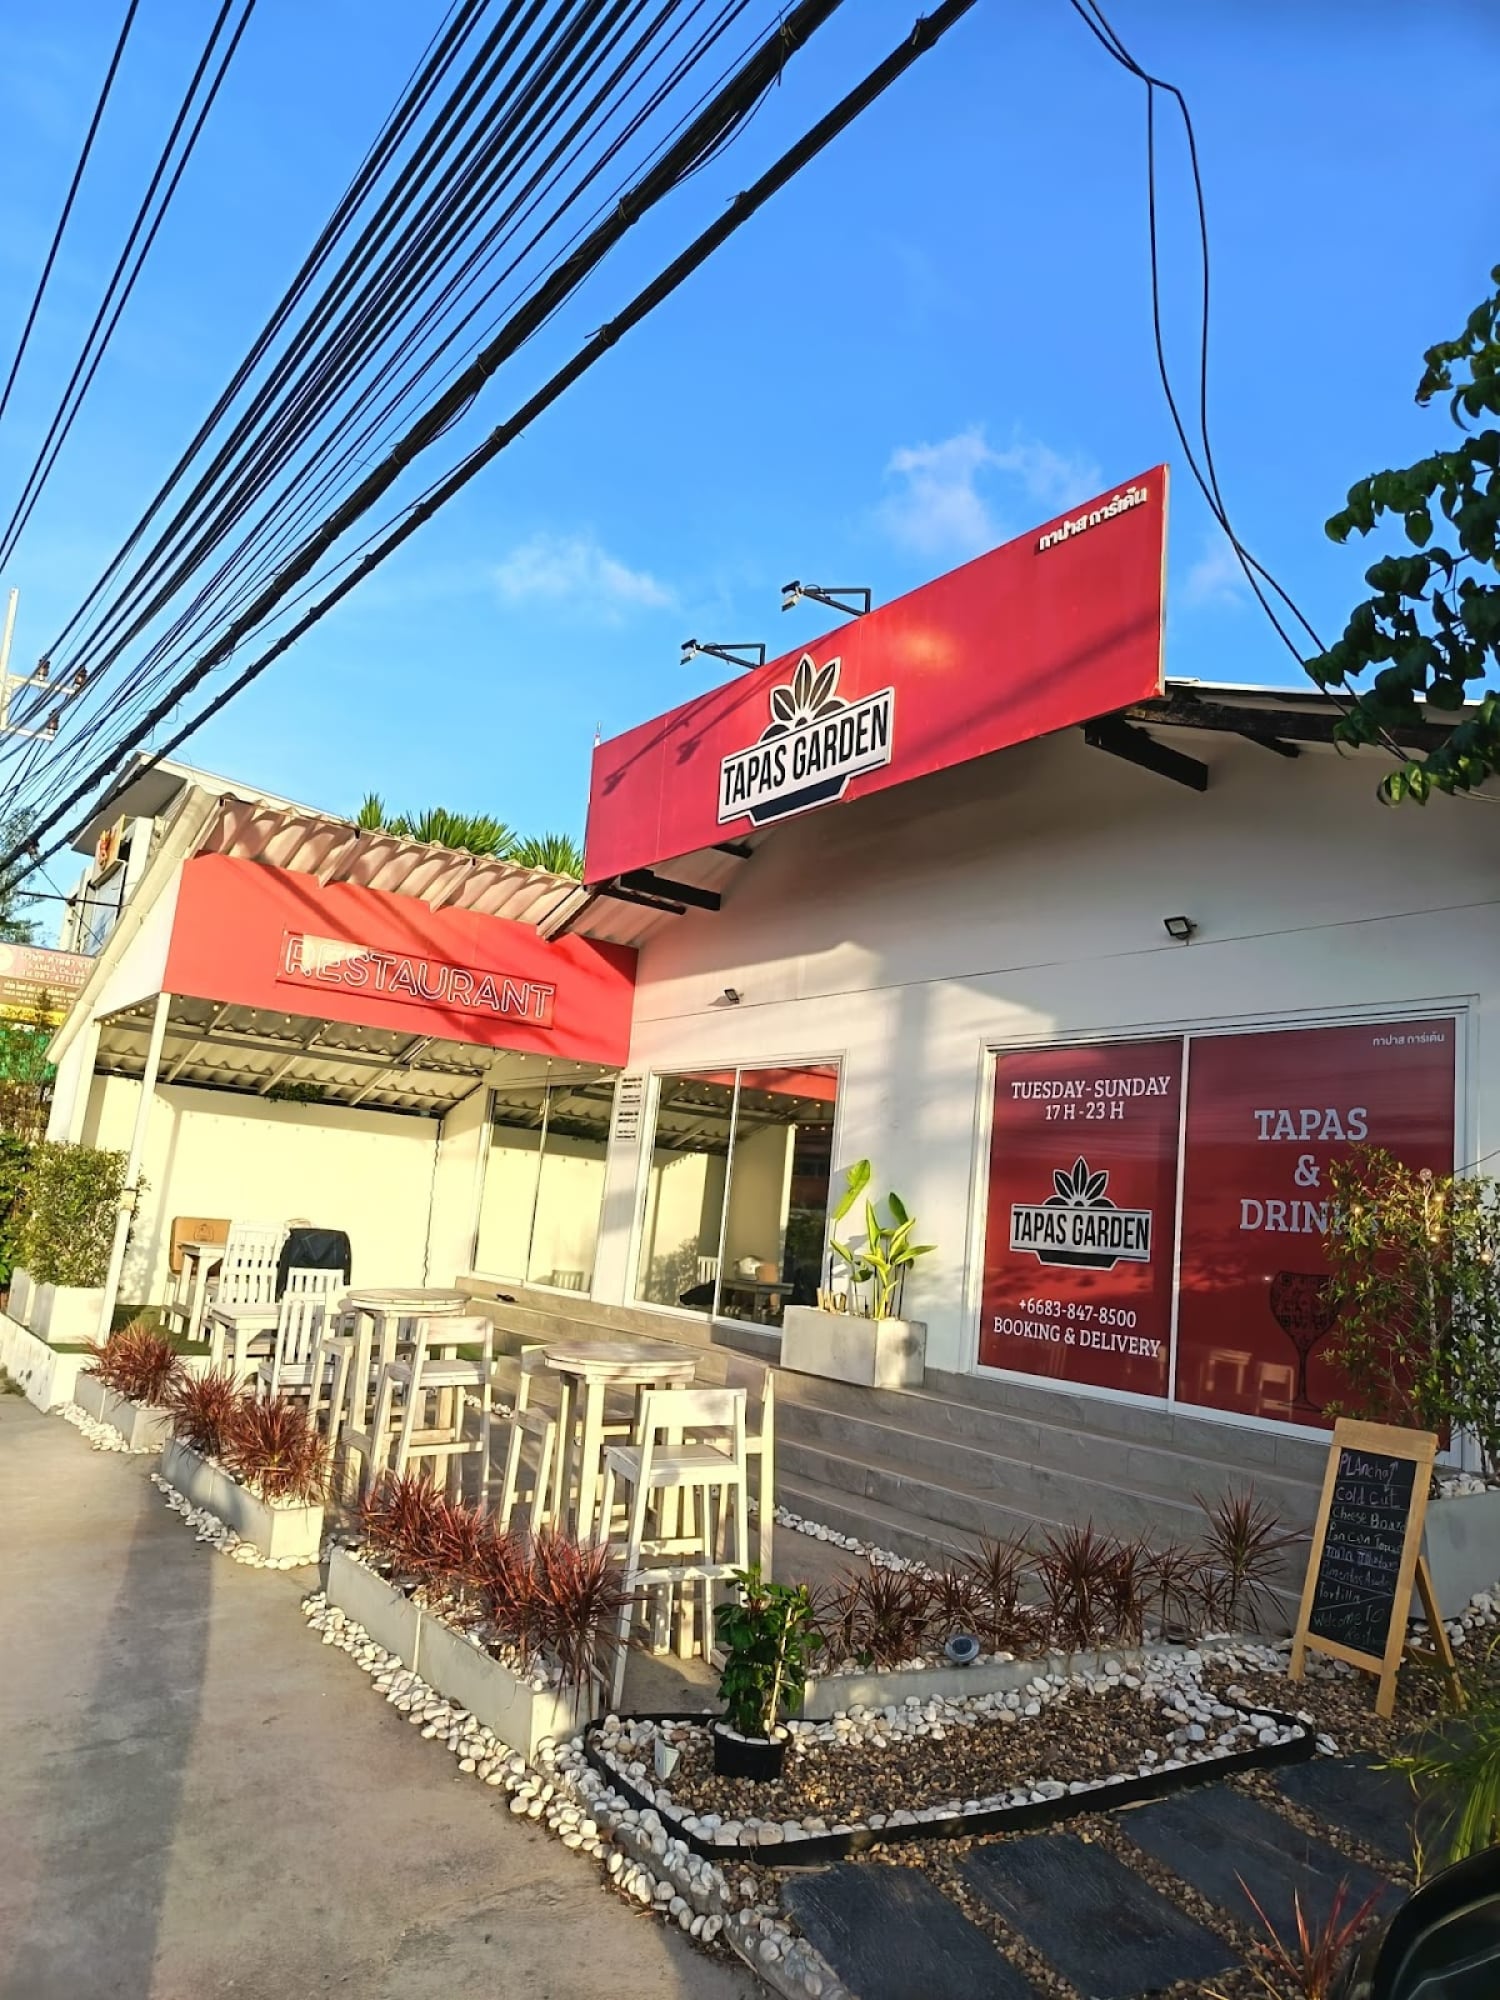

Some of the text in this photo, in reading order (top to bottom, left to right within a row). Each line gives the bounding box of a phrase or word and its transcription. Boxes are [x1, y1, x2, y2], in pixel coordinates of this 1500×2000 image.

[724, 701, 889, 805] TAPAS GARDEN
[285, 938, 554, 1018] RESTAURANT
[1253, 1107, 1368, 1141] TAPAS
[1294, 1154, 1321, 1187] &
[1013, 1211, 1150, 1251] TAPAS GARDEN
[1019, 1298, 1137, 1328] +6683-847-8500
[993, 1316, 1161, 1358] BOOKING & DELIVERY
